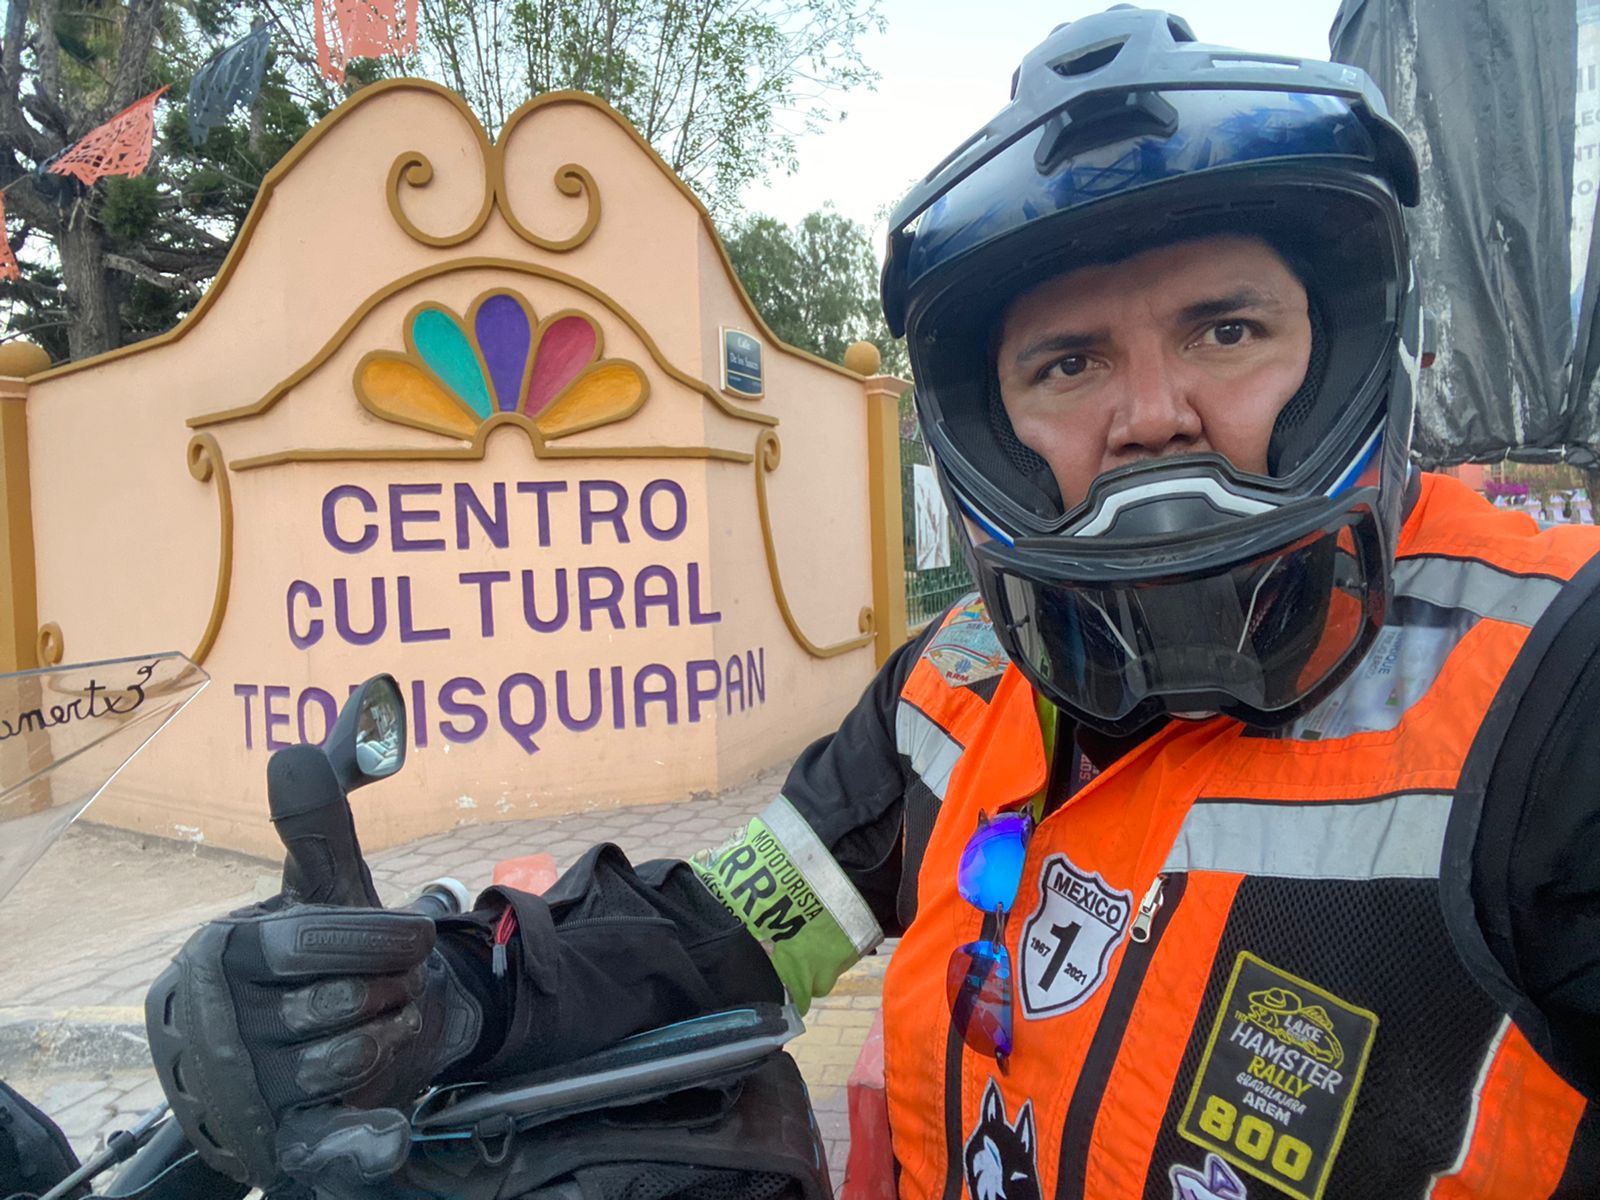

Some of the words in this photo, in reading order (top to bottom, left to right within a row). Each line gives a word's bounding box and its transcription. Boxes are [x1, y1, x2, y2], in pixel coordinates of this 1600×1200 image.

[321, 479, 688, 555] CENTRO
[286, 562, 722, 650] CULTURAL
[233, 647, 767, 755] TEQISQUIAPAN
[718, 844, 808, 944] RRM
[751, 829, 825, 922] MOTOTURISTA
[1053, 871, 1122, 925] MEXICO
[1030, 937, 1052, 958] 1967
[1037, 921, 1083, 993] 1
[1063, 962, 1088, 985] 2021
[1229, 1021, 1343, 1095] HAMSTER
[1283, 1014, 1325, 1043] LAKE
[1236, 1071, 1307, 1116] GUADALAJARA
[1242, 1091, 1292, 1127] AREM
[1246, 1055, 1313, 1099] RALLY
[1198, 1094, 1313, 1182] 800
